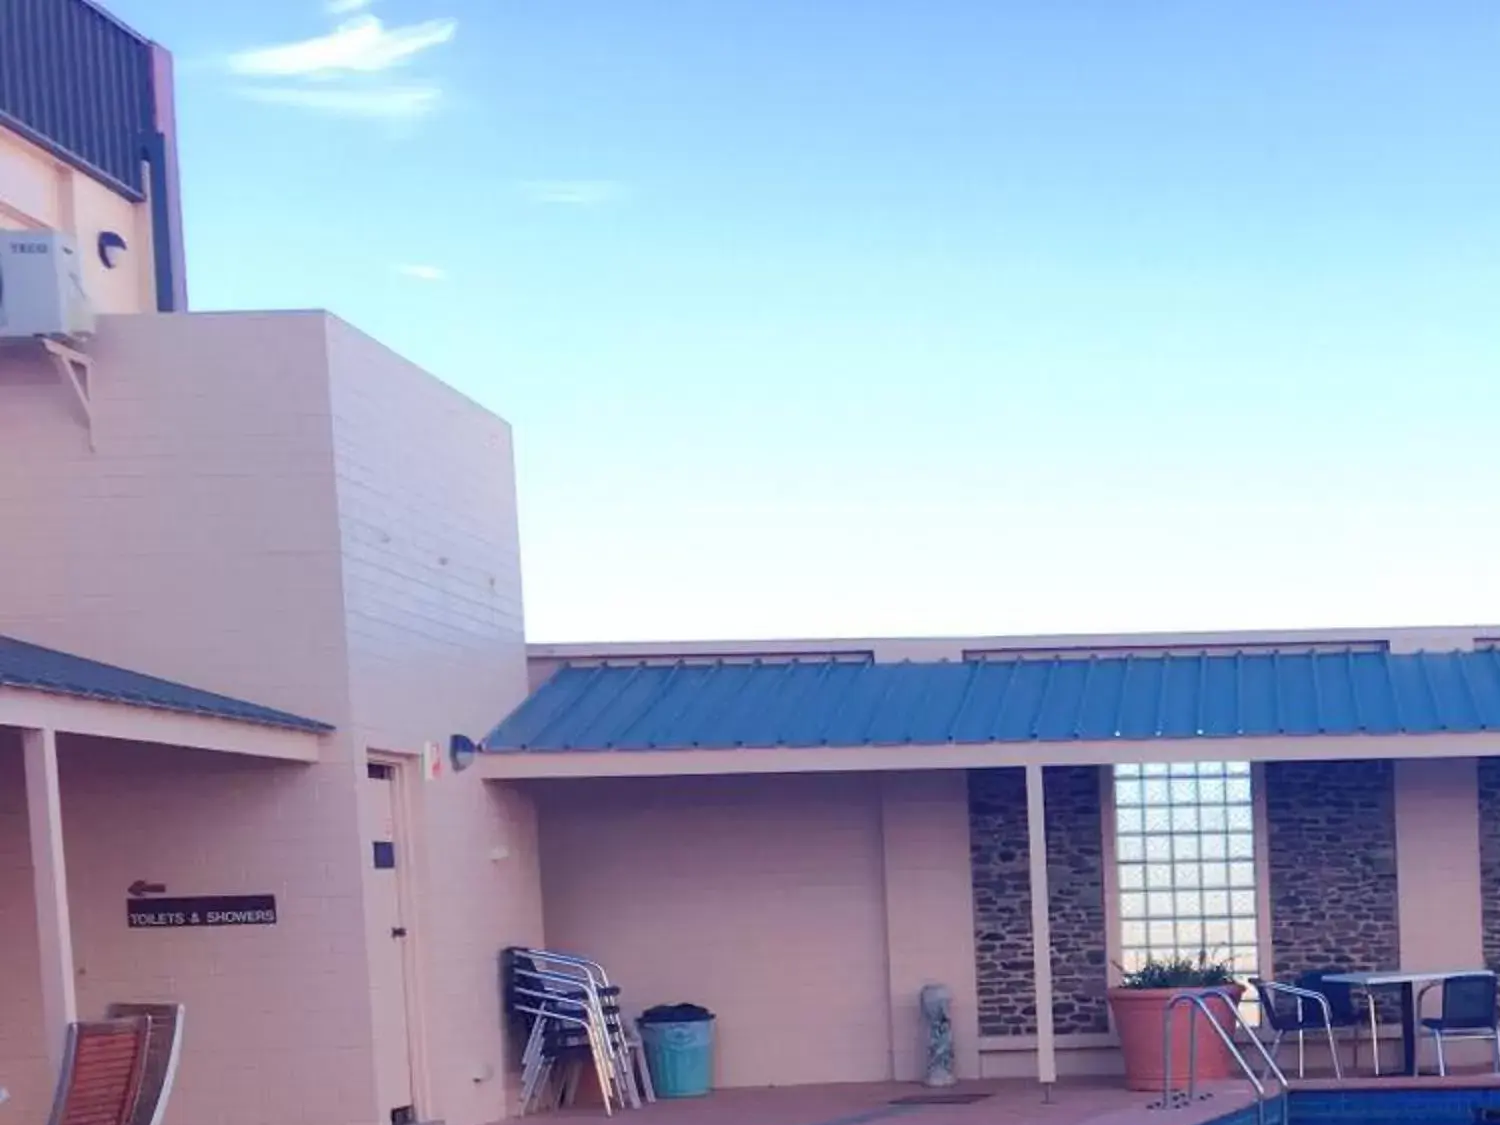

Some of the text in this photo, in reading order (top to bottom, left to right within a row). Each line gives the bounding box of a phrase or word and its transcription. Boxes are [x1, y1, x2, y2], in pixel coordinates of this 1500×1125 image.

[130, 910, 275, 925] TOILETS & SHOWERS
